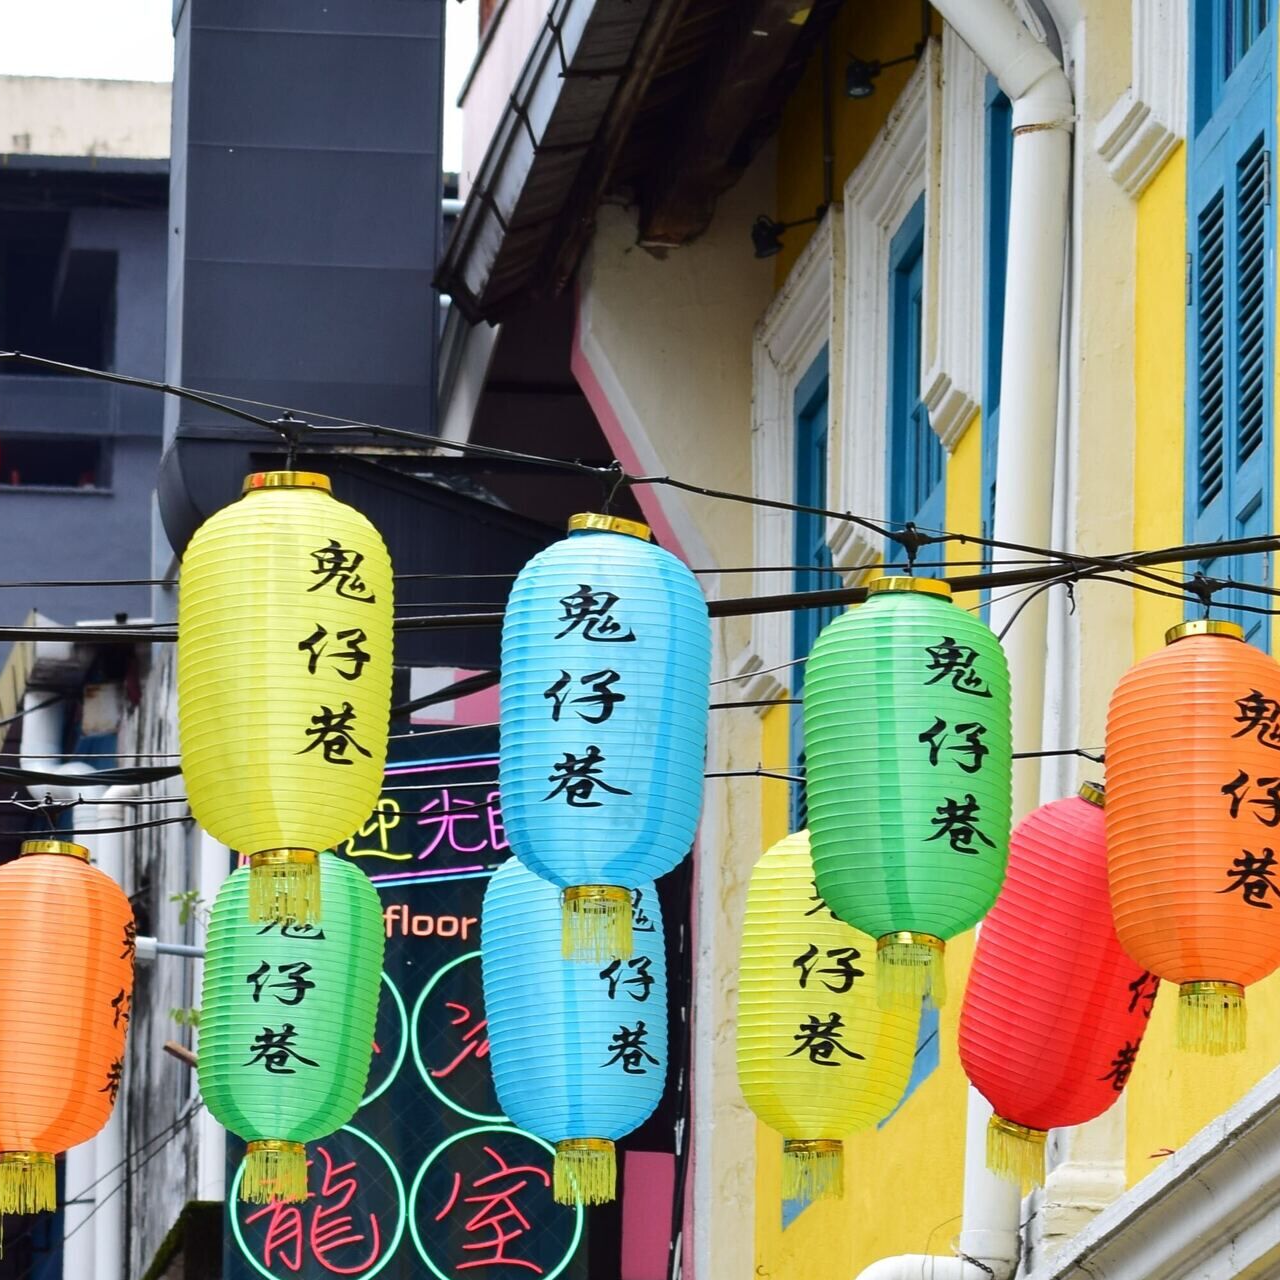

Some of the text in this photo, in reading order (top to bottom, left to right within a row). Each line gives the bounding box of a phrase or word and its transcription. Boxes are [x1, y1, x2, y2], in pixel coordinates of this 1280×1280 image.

[294, 538, 376, 766] 鬼仔巷
[541, 583, 638, 808] 鬼仔巷
[918, 634, 997, 856] 鬼仔巷
[383, 903, 478, 941] floor
